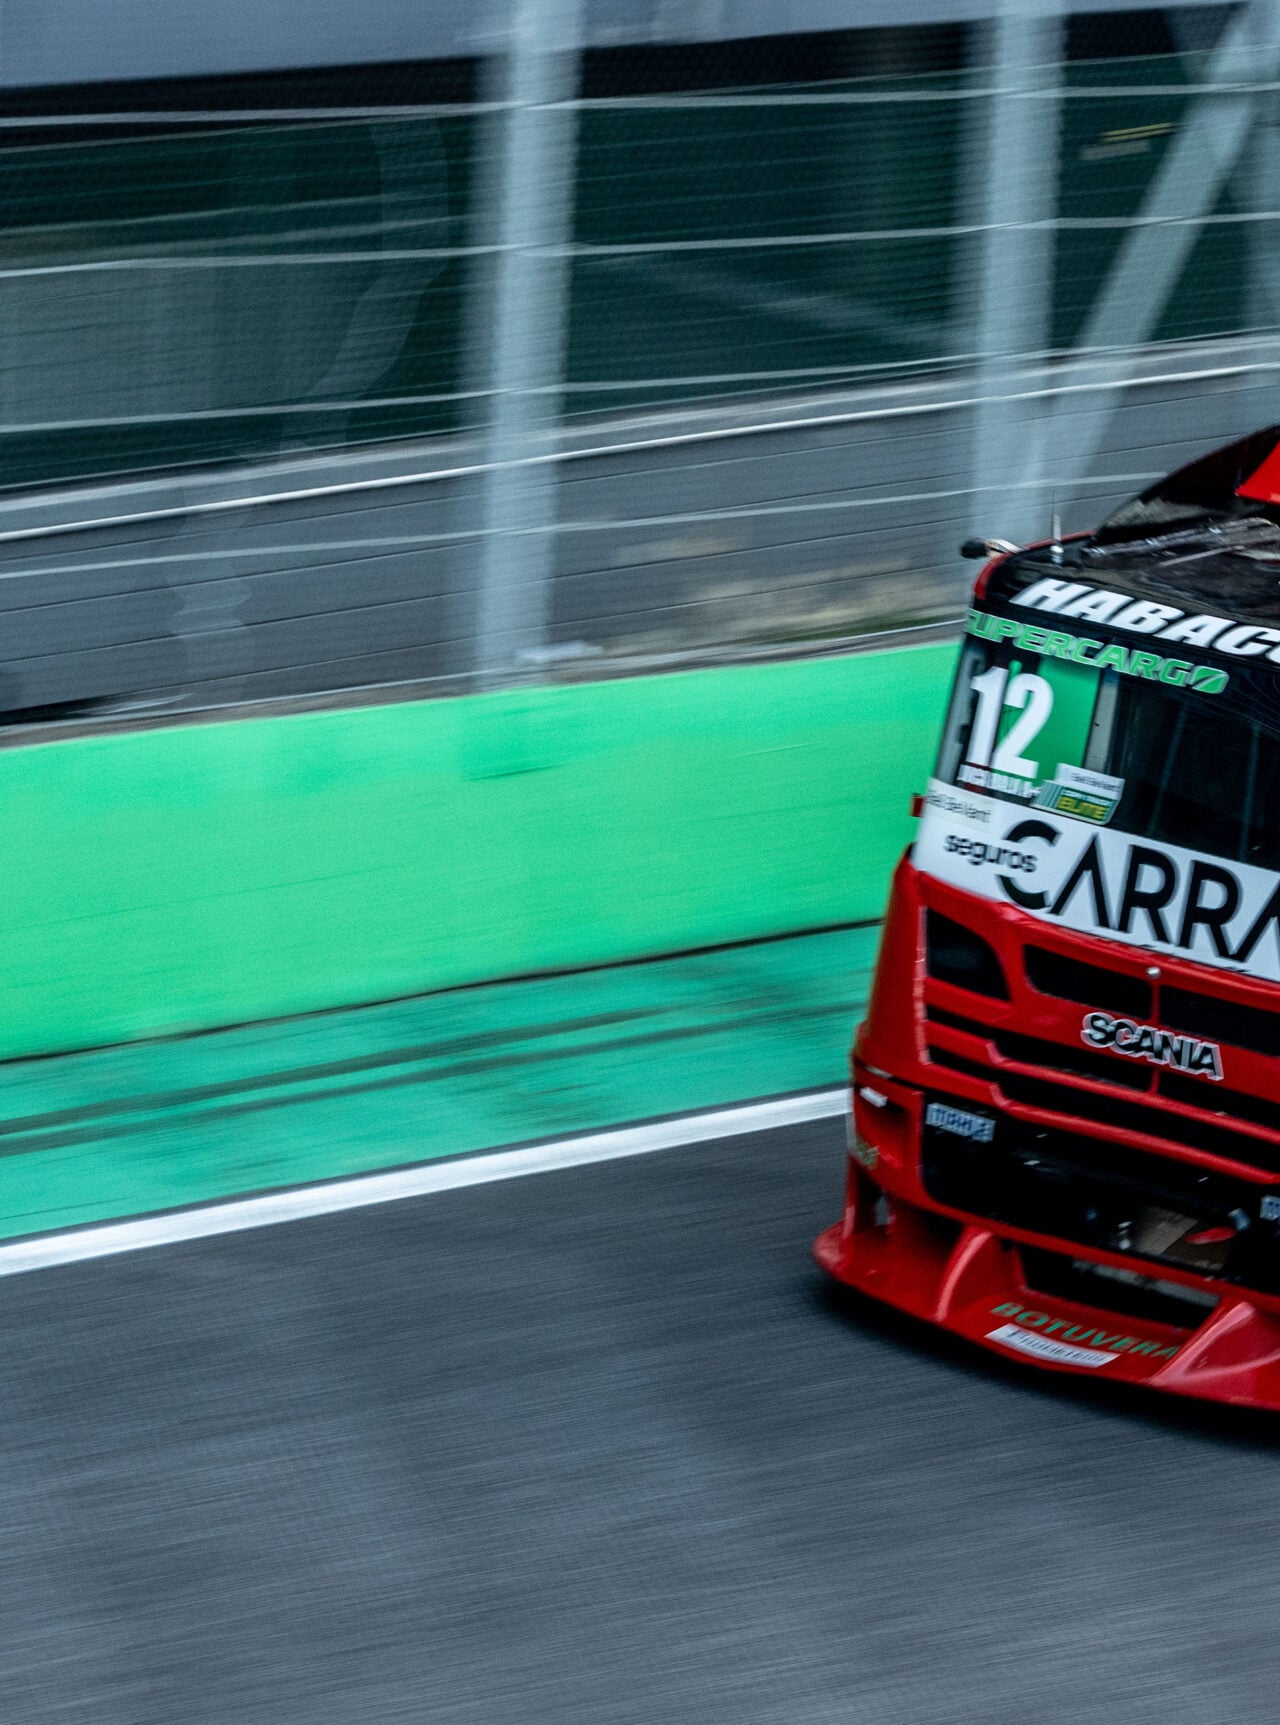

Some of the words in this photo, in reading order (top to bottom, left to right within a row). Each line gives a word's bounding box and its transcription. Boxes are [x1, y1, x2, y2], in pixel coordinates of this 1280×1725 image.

[968, 664, 1054, 778] 12
[944, 833, 1037, 873] seguros
[1080, 1011, 1225, 1082] SCANIA
